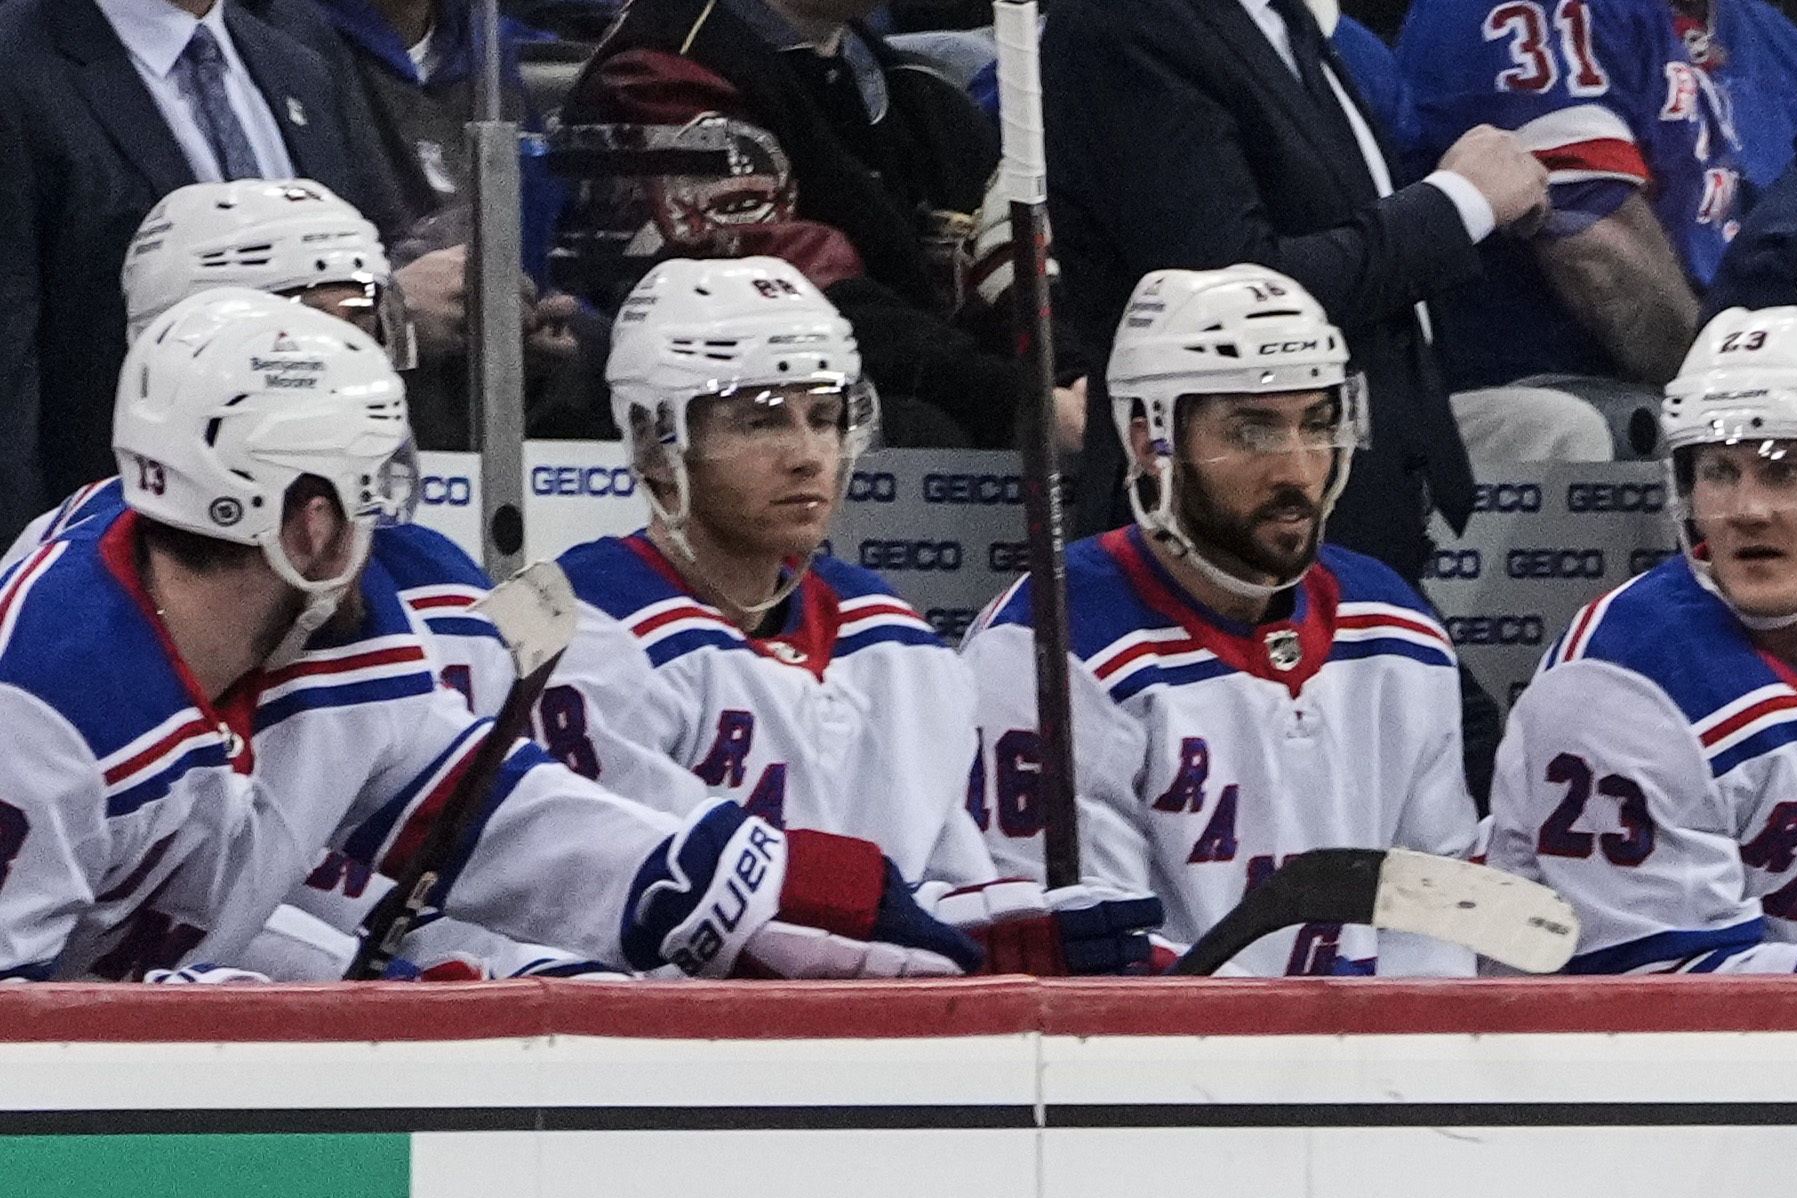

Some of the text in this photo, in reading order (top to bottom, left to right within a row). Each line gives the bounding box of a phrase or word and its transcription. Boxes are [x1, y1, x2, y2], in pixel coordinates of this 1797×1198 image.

[1483, 0, 1608, 96] 31
[1719, 330, 1768, 354] 23
[531, 465, 637, 498] GEICO
[858, 540, 963, 571] GEICO
[1507, 549, 1604, 580] GEICO
[1447, 616, 1544, 647] GEICO
[1537, 751, 1656, 867] 23
